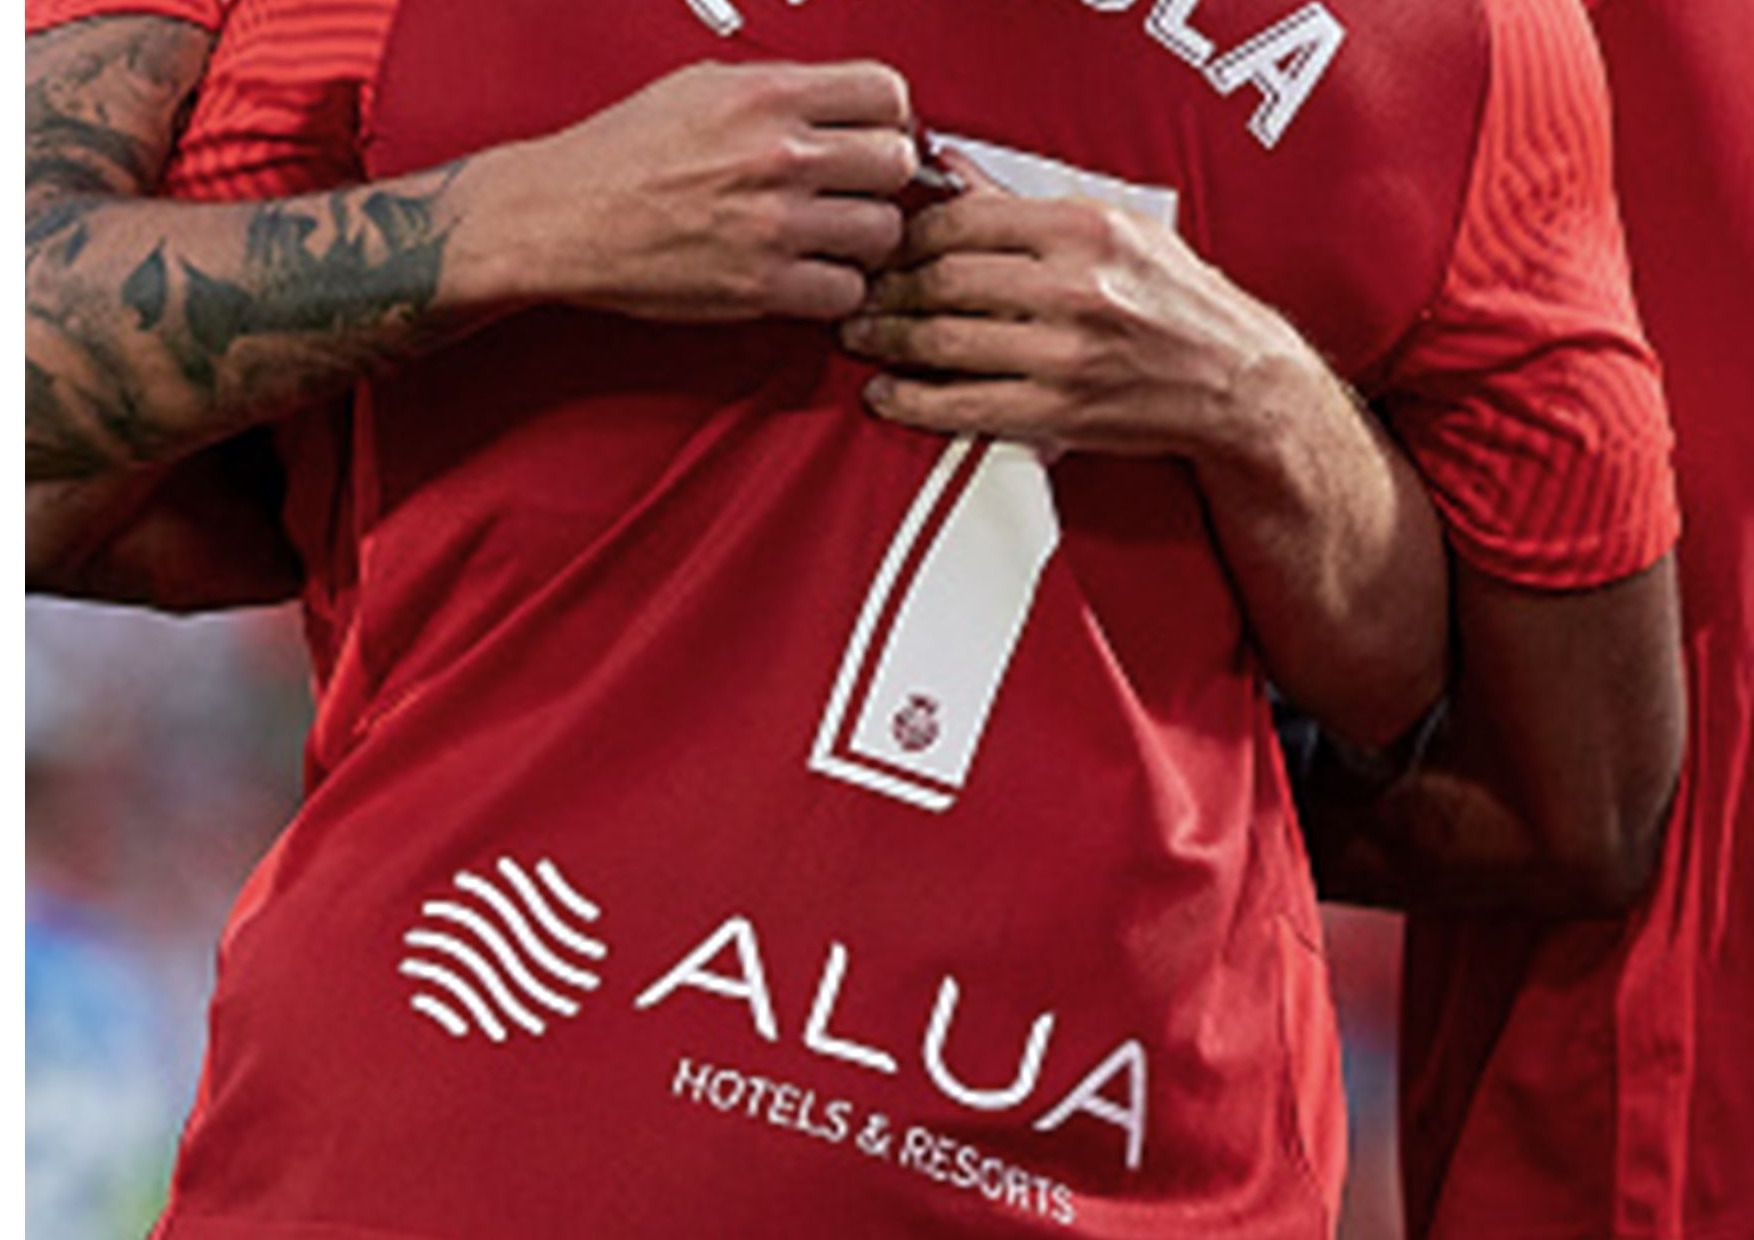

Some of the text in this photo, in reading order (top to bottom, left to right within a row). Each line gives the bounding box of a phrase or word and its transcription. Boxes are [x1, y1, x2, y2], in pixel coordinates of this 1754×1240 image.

[634, 915, 1148, 1170] ALUA
[671, 1057, 1078, 1226] HOTELS & RESORTS
